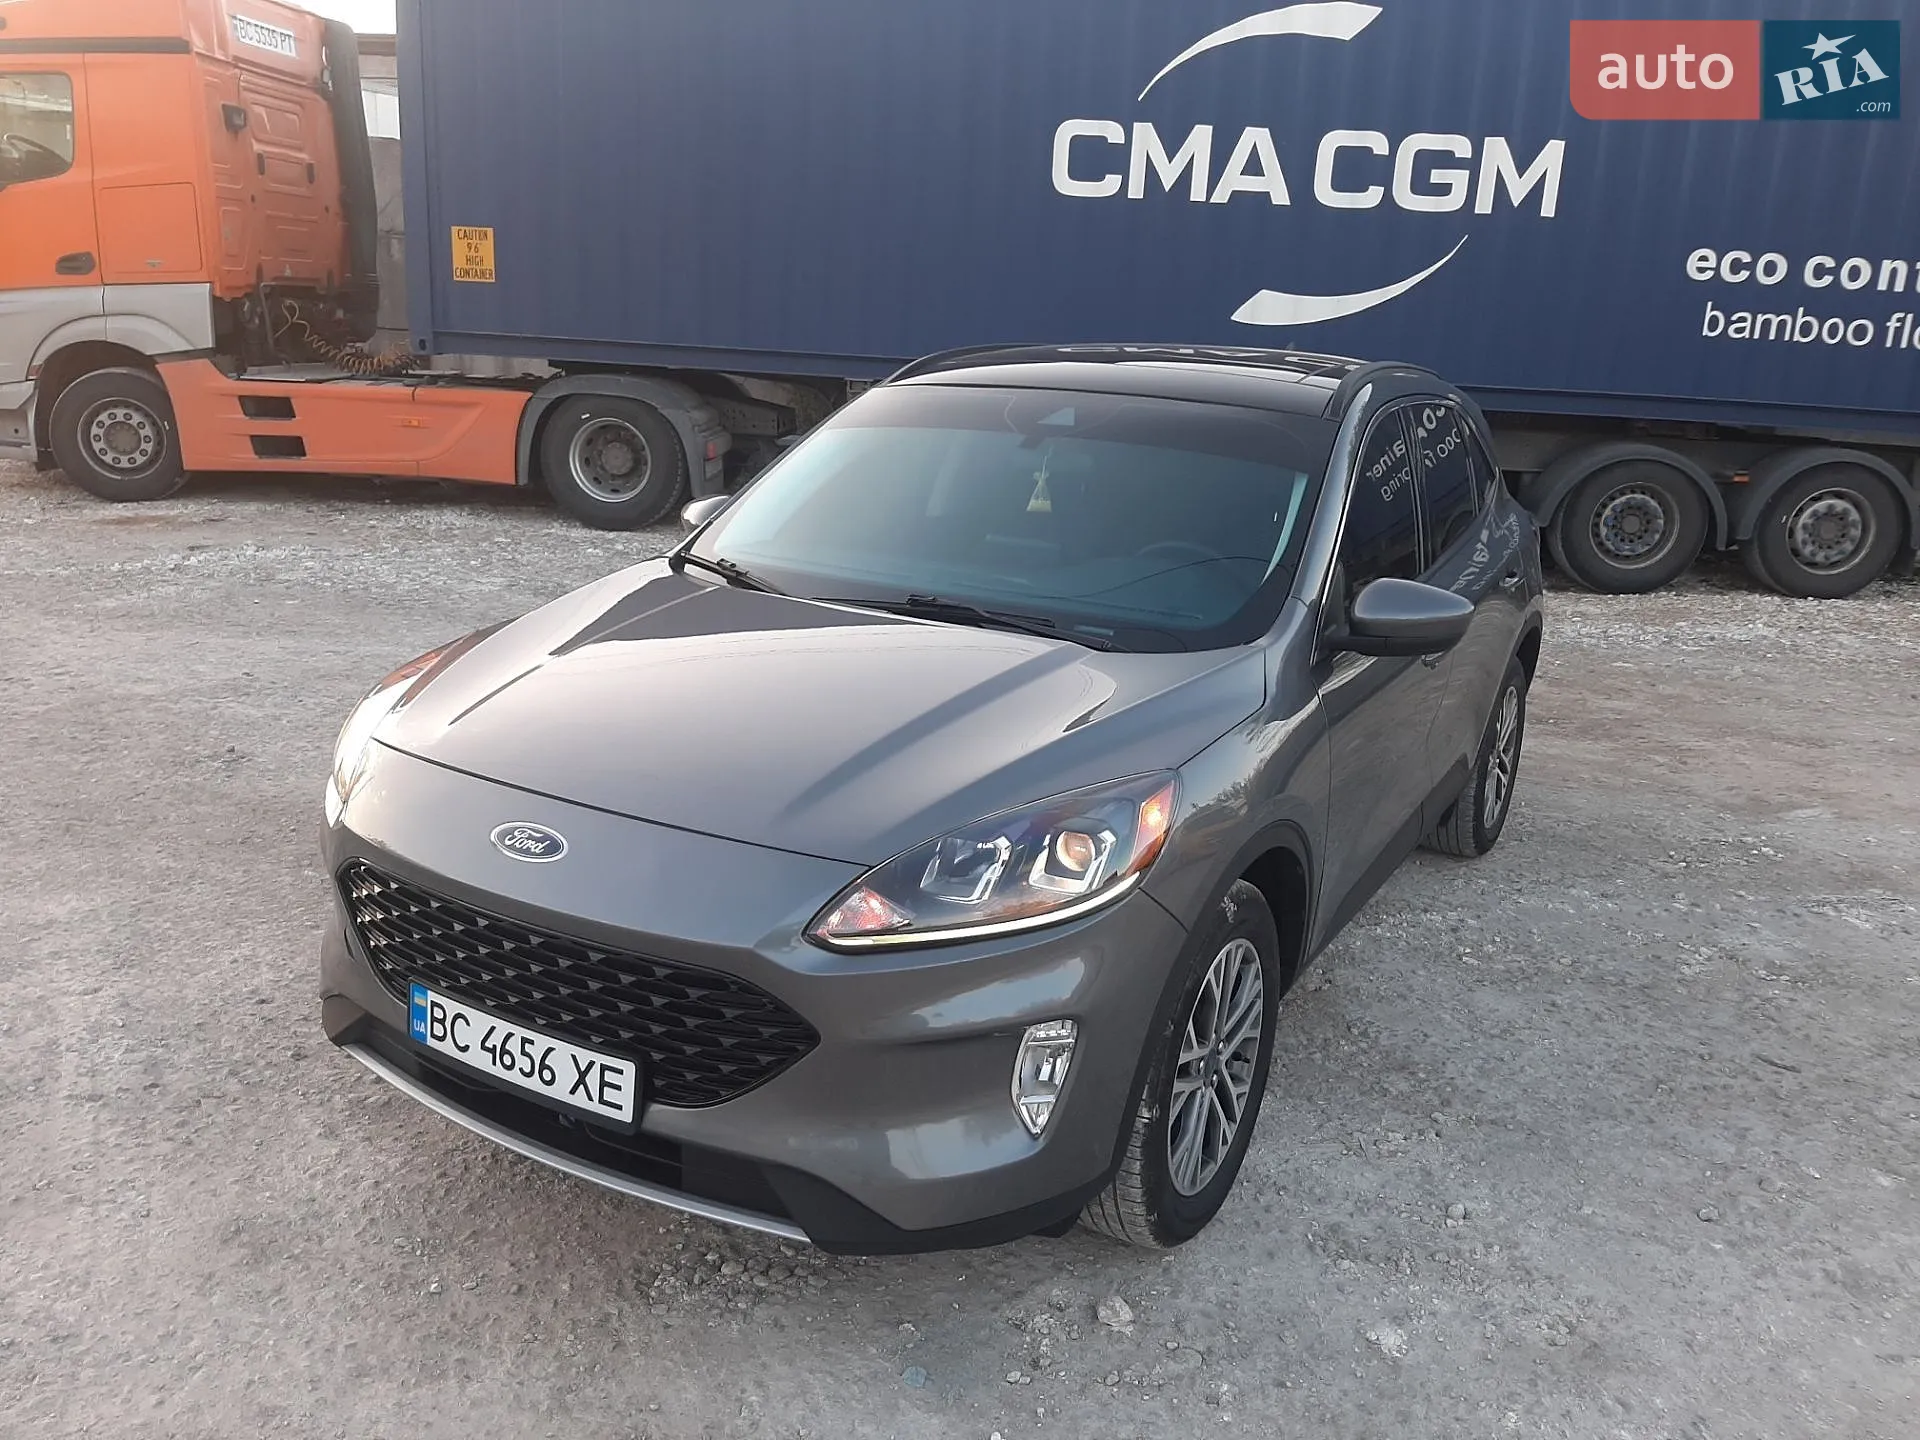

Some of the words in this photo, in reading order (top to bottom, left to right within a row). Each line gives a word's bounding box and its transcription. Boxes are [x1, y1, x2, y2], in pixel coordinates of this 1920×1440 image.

[238, 18, 254, 41] BC
[254, 23, 278, 49] 5535
[279, 31, 294, 53] PT
[1051, 118, 1291, 206] CMA
[1313, 129, 1566, 218] CGM
[465, 254, 484, 267] HIGH
[1686, 247, 1789, 286] eco
[1702, 301, 1874, 347] bamboo
[1885, 311, 1920, 350] fl
[504, 827, 551, 854] Ford
[414, 1020, 426, 1035] UA
[430, 999, 471, 1053] BC
[480, 1024, 557, 1087] 4656
[568, 1053, 624, 1111] XE
